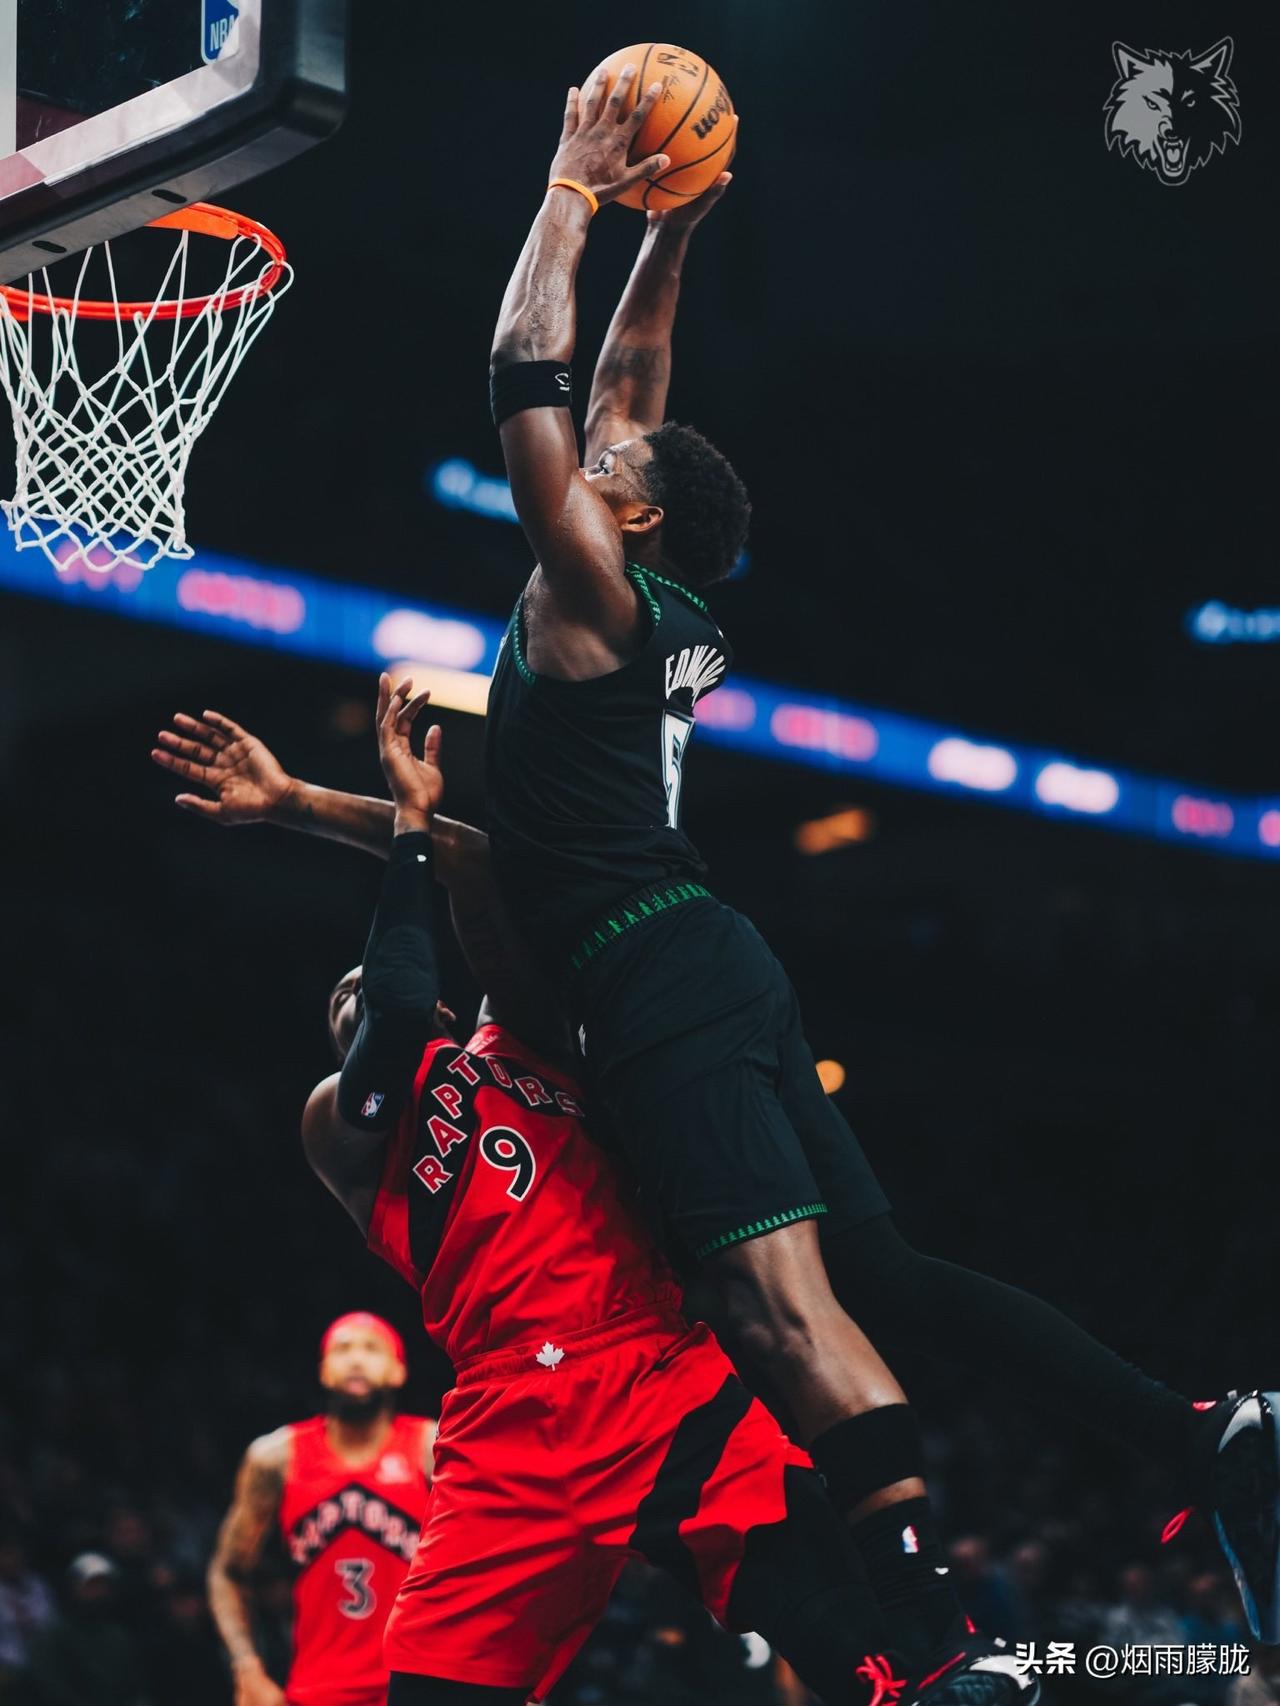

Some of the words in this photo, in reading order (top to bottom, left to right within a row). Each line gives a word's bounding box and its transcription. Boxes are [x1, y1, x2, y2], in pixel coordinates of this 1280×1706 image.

[412, 1051, 586, 1194] RAPTORS
[479, 1125, 536, 1202] 9
[334, 1557, 377, 1620] 3
